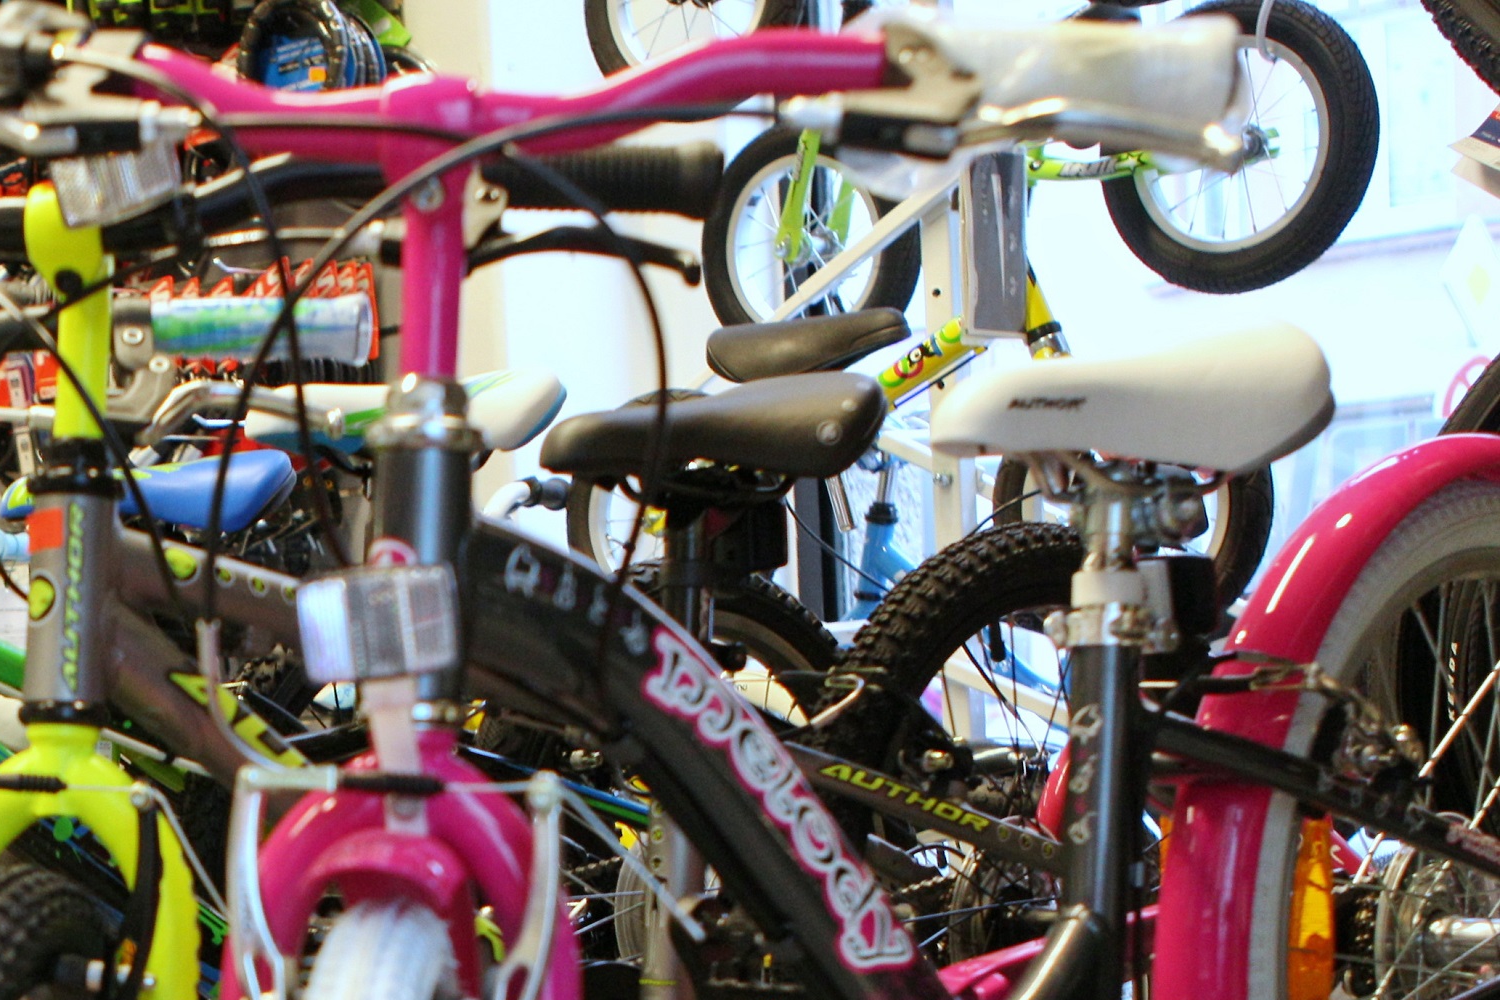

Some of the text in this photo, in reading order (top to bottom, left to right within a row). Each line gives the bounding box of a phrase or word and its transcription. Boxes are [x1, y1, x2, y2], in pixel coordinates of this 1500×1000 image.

[1007, 395, 1088, 412] AUTHOR
[1447, 641, 1460, 722] KENDA
[819, 760, 991, 841] AUTHOR
